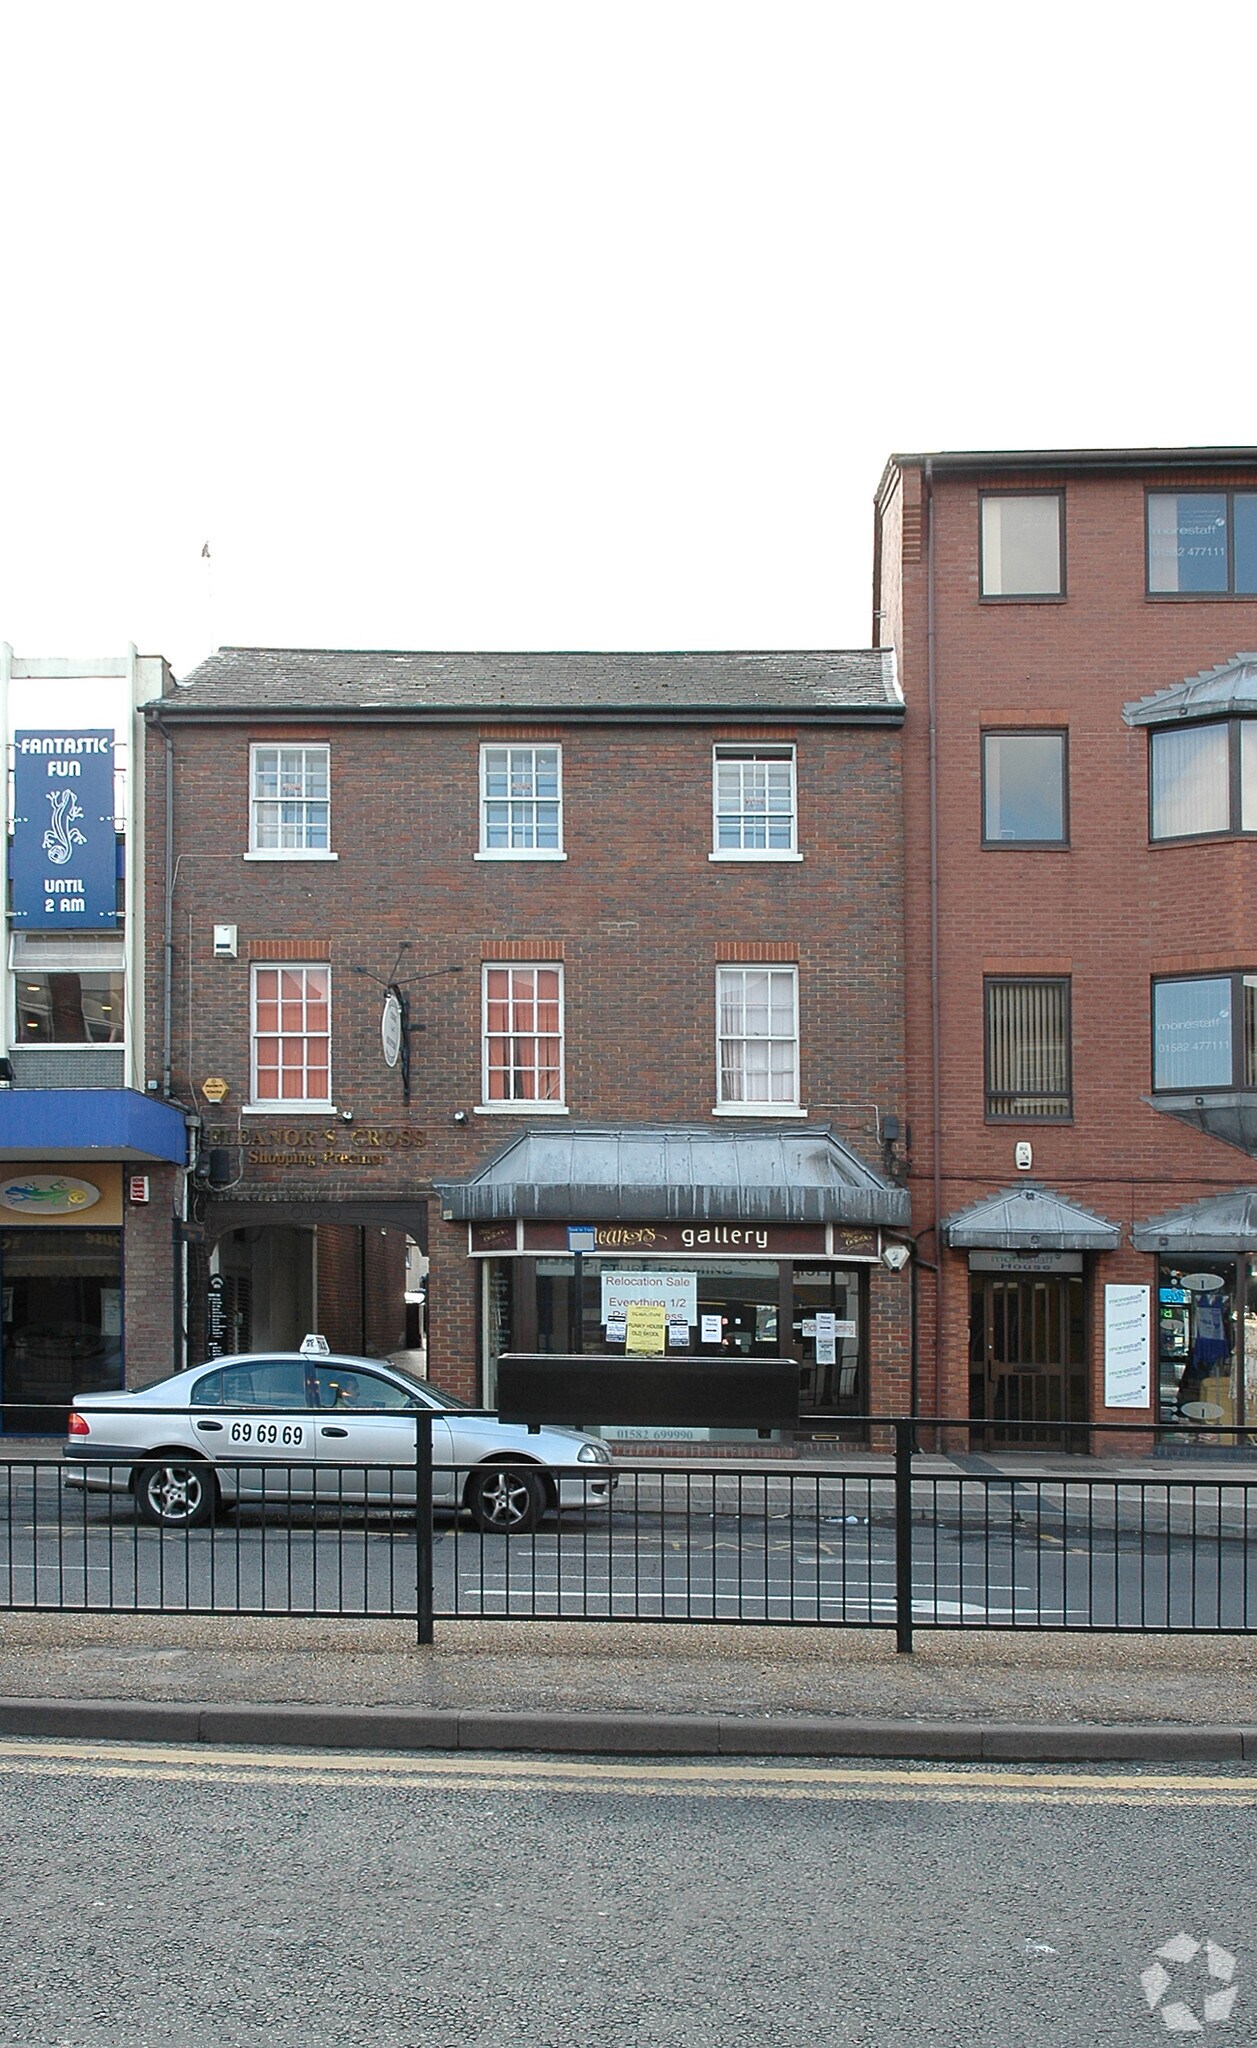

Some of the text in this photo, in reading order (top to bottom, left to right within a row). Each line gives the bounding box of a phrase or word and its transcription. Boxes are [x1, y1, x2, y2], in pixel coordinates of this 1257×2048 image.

[1187, 547, 1225, 557] 477111
[21, 737, 109, 754] FANTASTIC
[47, 760, 81, 777] FUN
[44, 879, 85, 893] UNTIL
[45, 898, 85, 912] 2 AM
[1158, 1017, 1220, 1030] morestaff
[1158, 1041, 1229, 1053] 01582 477111
[207, 1129, 426, 1147] ELEANOR'S CROSS
[249, 1151, 316, 1167] Shopping
[682, 1226, 768, 1248] gallery
[1001, 1263, 1051, 1271] House
[606, 1276, 690, 1287] Relocation Sale
[609, 1298, 687, 1308] Everything 1/2
[231, 1422, 303, 1445] 69 69 69
[617, 1429, 694, 1440] 01582 699990
